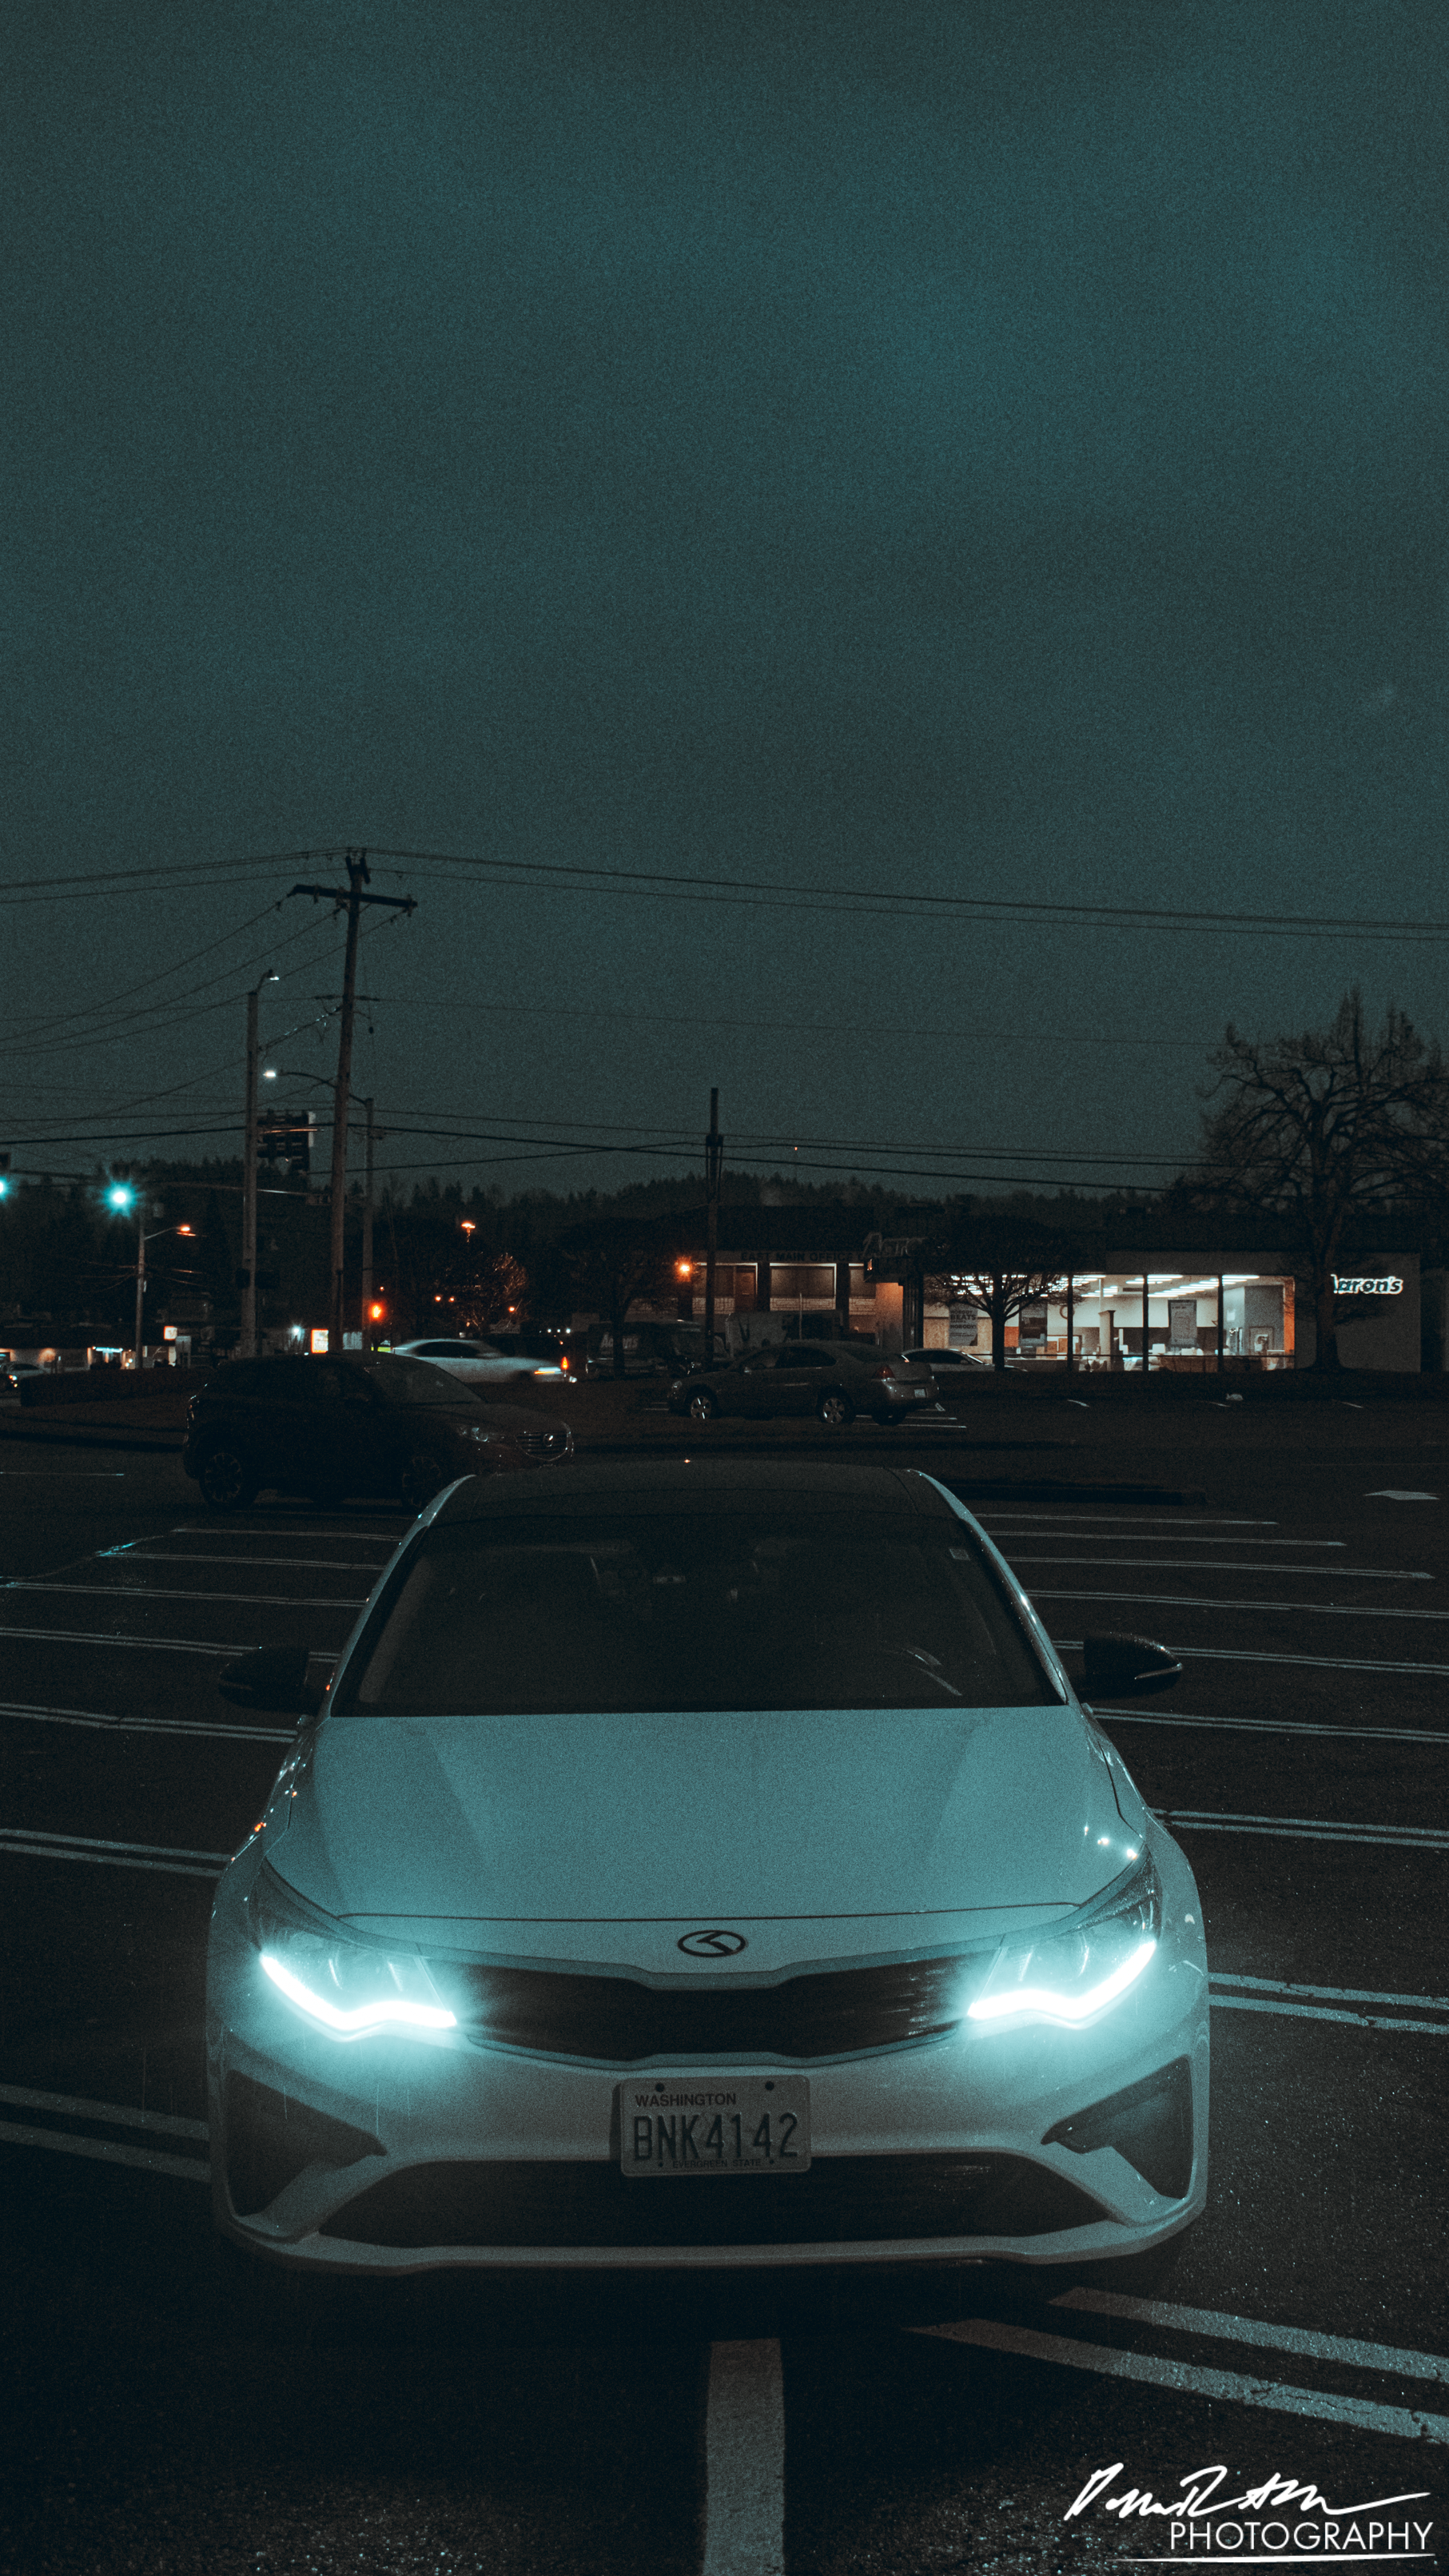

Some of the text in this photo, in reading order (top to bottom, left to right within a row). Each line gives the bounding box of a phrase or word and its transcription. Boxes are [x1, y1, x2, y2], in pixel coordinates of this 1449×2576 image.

[740, 1252, 769, 1261] EAST
[775, 1252, 805, 1261] MAIN
[810, 1252, 853, 1261] OFFICE
[1330, 1273, 1404, 1295] aron's
[635, 2093, 737, 2108] WASHINGTON
[634, 2112, 798, 2161] BNK4142
[672, 2159, 762, 2169] EVERGREEN STATE
